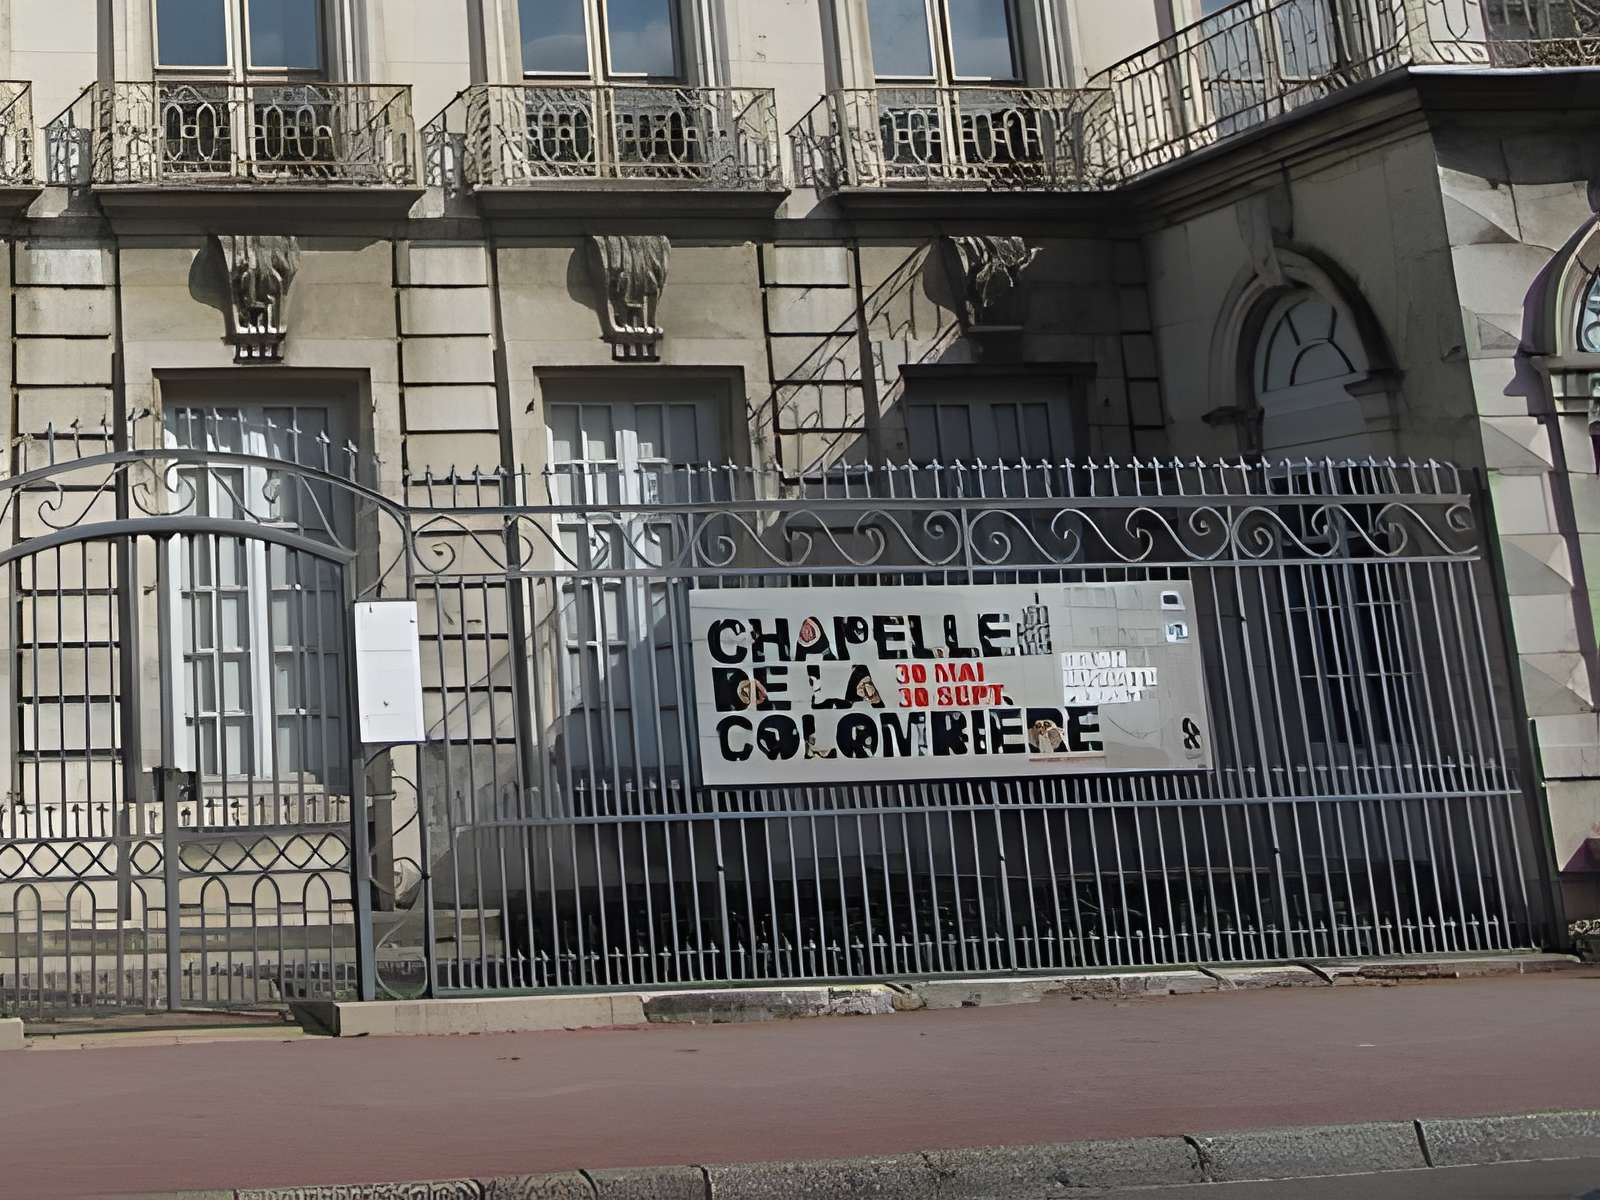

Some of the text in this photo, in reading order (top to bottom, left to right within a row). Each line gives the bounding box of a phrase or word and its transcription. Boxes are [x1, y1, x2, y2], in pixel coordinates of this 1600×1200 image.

[707, 613, 1016, 664] CHAPELLE
[806, 665, 886, 710] LA
[934, 662, 984, 683] MAI
